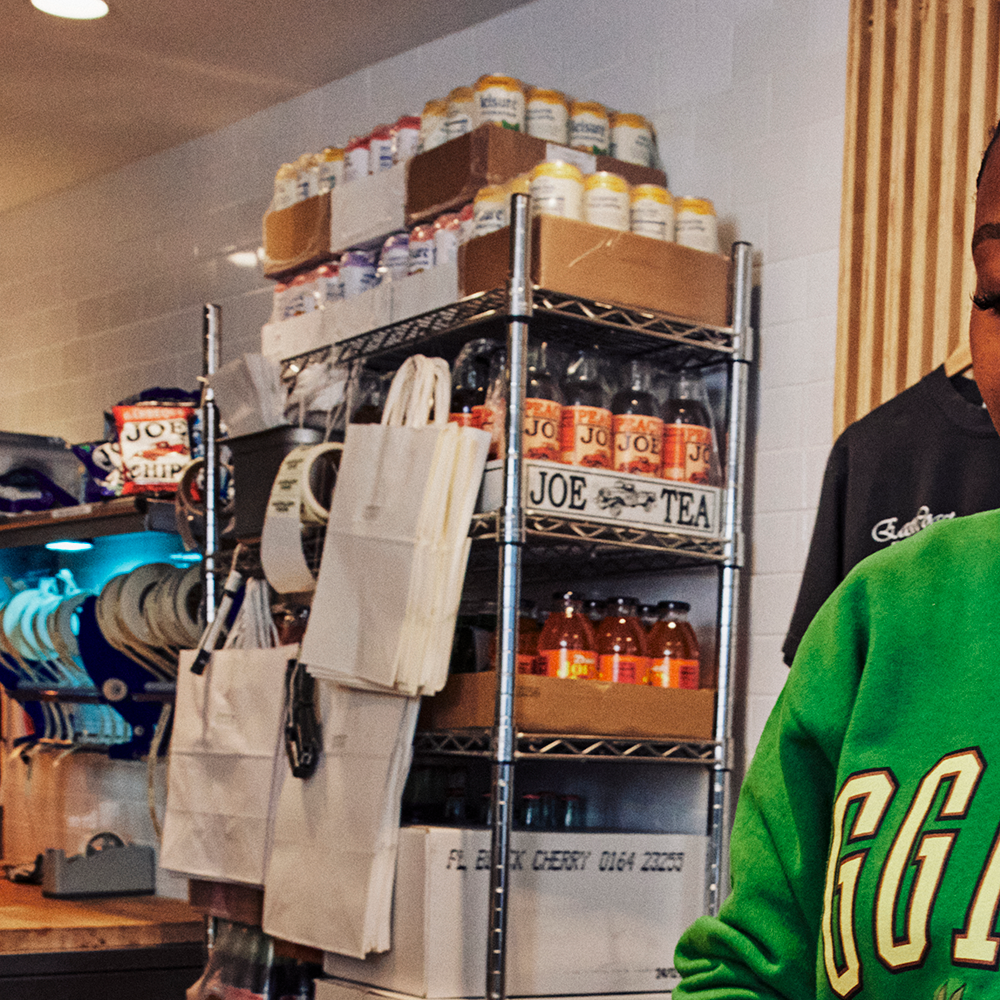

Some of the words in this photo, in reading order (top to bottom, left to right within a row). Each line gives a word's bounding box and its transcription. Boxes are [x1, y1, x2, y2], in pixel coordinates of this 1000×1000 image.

[126, 421, 188, 442] JOE
[530, 471, 587, 511] JOE
[661, 488, 710, 528] TEA
[532, 850, 592, 871] CHERRY
[599, 851, 635, 871] 0164
